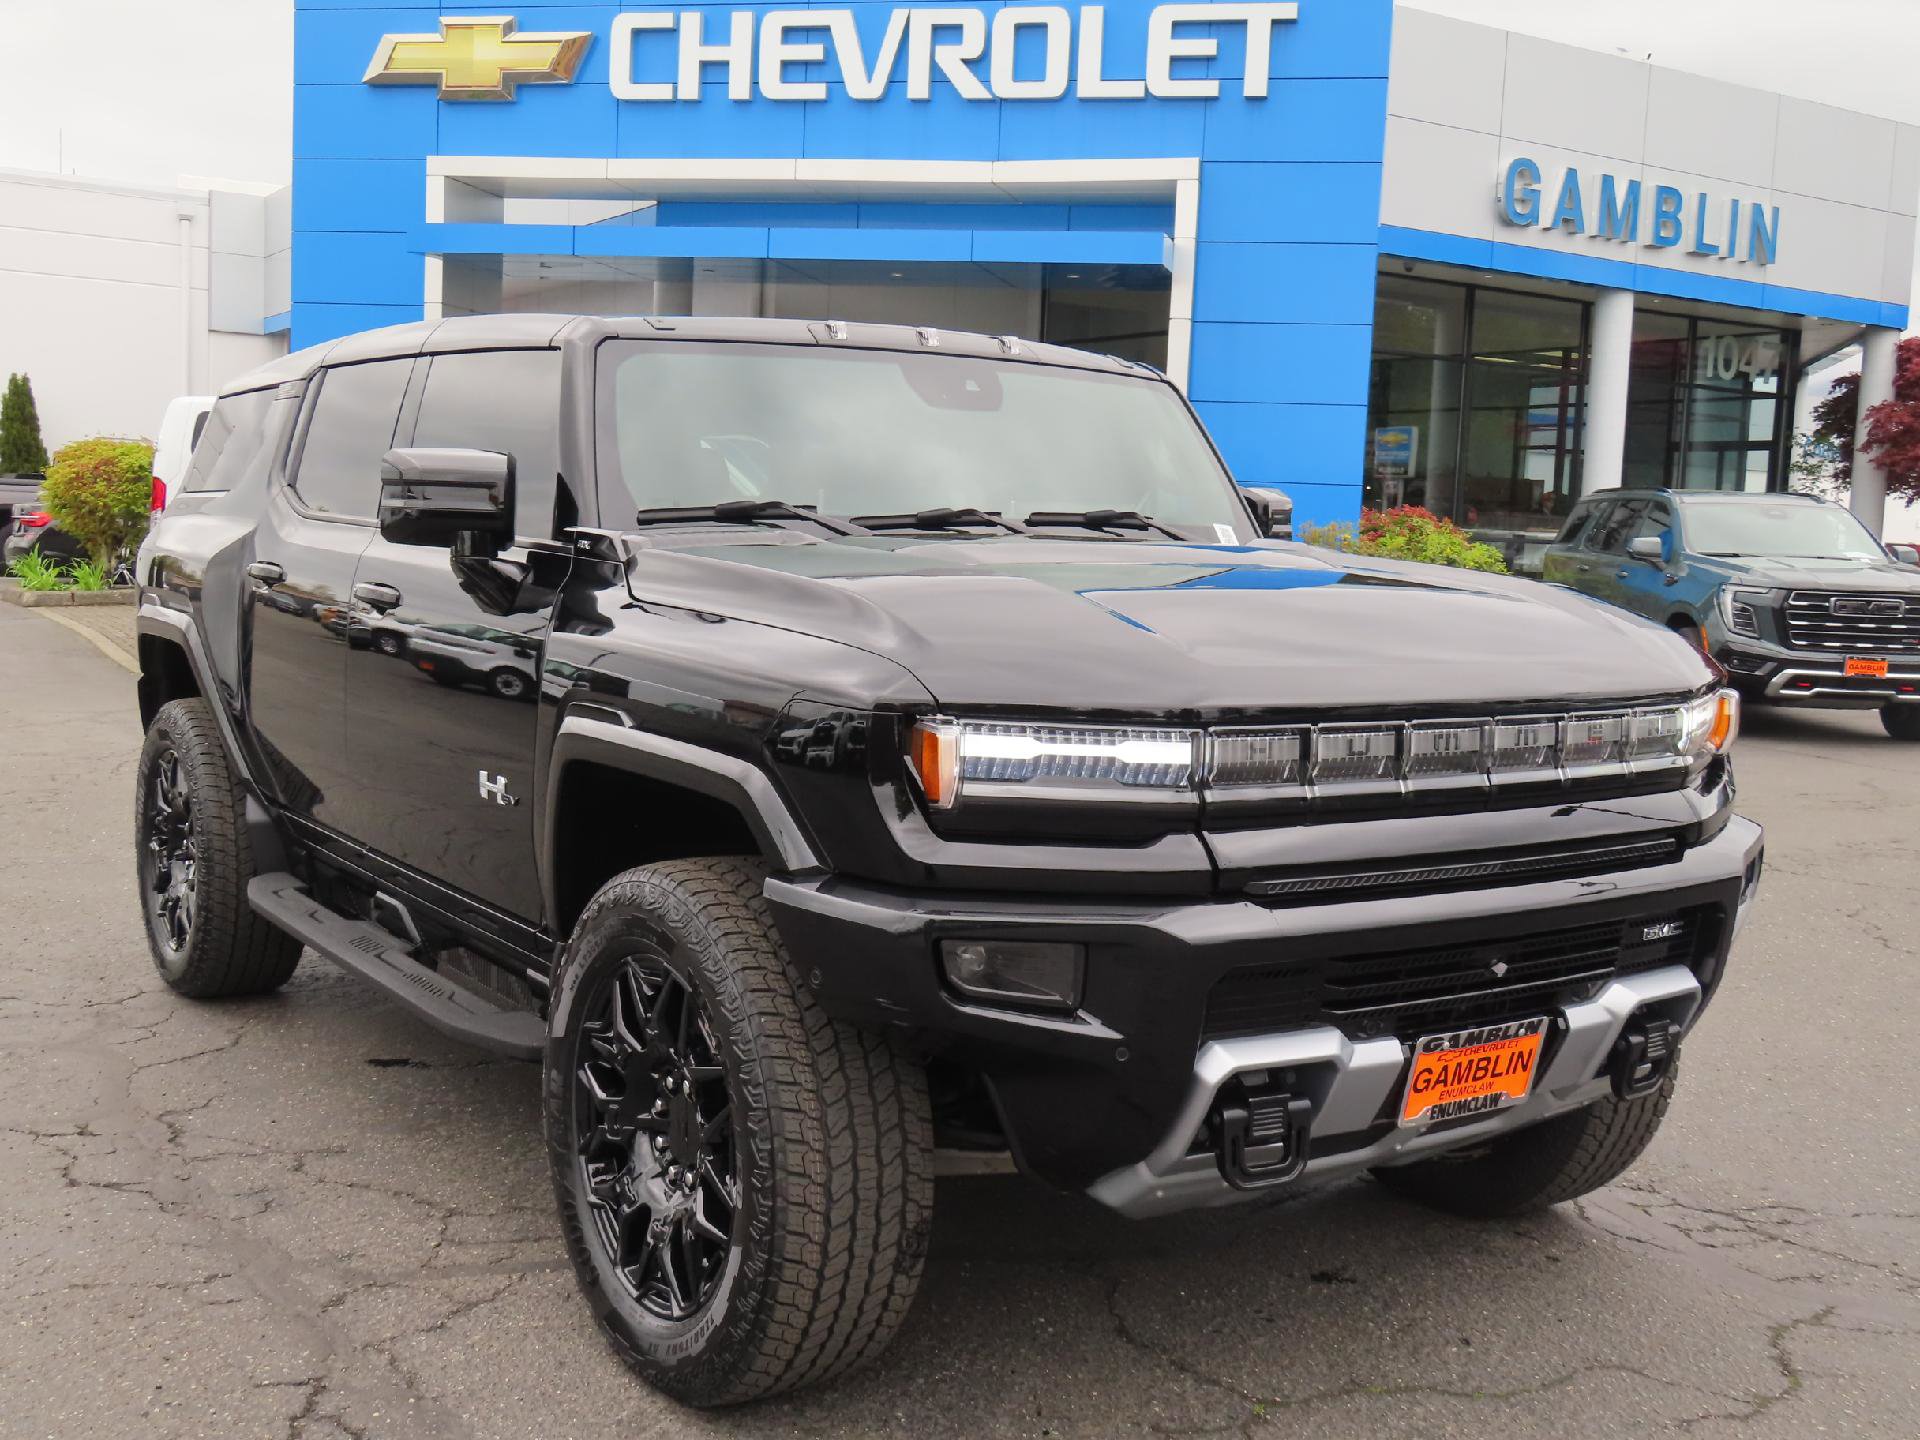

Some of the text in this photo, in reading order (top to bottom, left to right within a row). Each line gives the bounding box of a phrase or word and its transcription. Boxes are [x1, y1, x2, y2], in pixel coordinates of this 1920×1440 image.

[610, 3, 1298, 101] CHEVROLET
[1504, 157, 1780, 264] GAMBLIN
[1701, 336, 1782, 384] 1047
[1848, 663, 1885, 672] GAMBLIN
[1642, 922, 1684, 940] GMC
[1422, 1019, 1545, 1053] GAMBLIN
[1463, 1039, 1520, 1057] CHEVROLET
[1412, 1048, 1533, 1094] GAMBLIN
[1438, 1080, 1495, 1101] ENUMCLAW
[1429, 1092, 1504, 1121] ENUMCLAW
